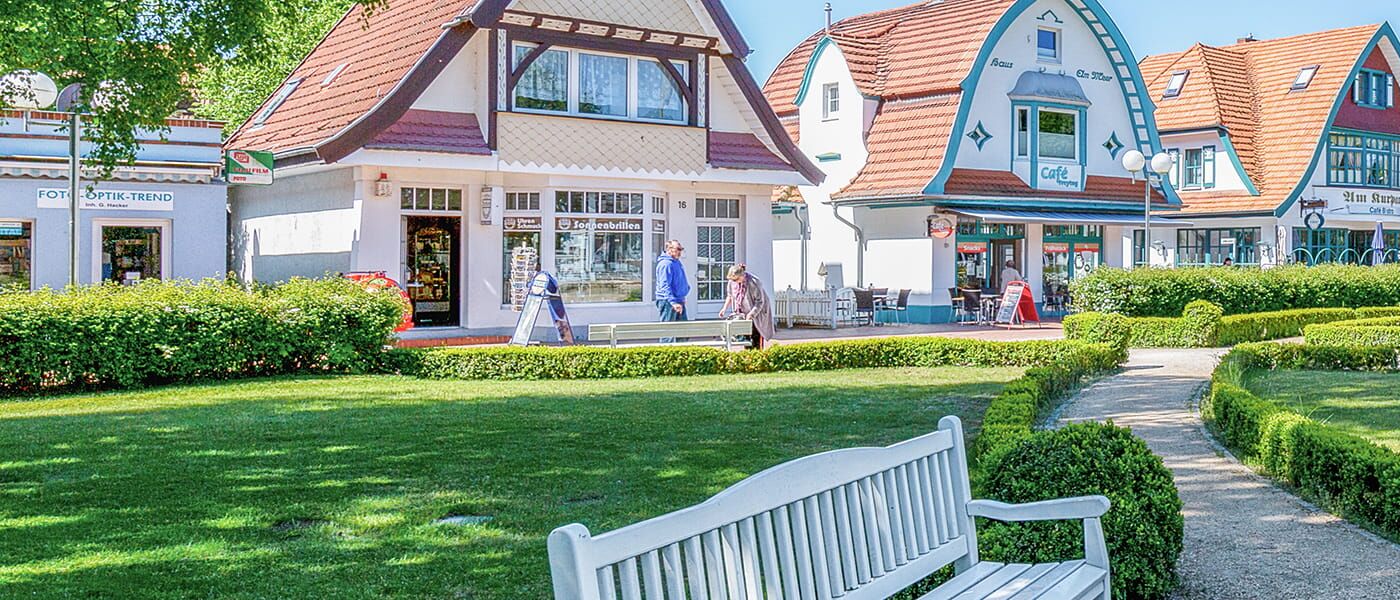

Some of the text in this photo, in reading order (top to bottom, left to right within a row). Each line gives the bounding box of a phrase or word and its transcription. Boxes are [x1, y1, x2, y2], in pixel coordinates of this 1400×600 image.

[1040, 166, 1069, 180] Café
[1343, 190, 1367, 203] Am
[677, 200, 688, 209] 16
[573, 220, 641, 230] Sonnenbrillen
